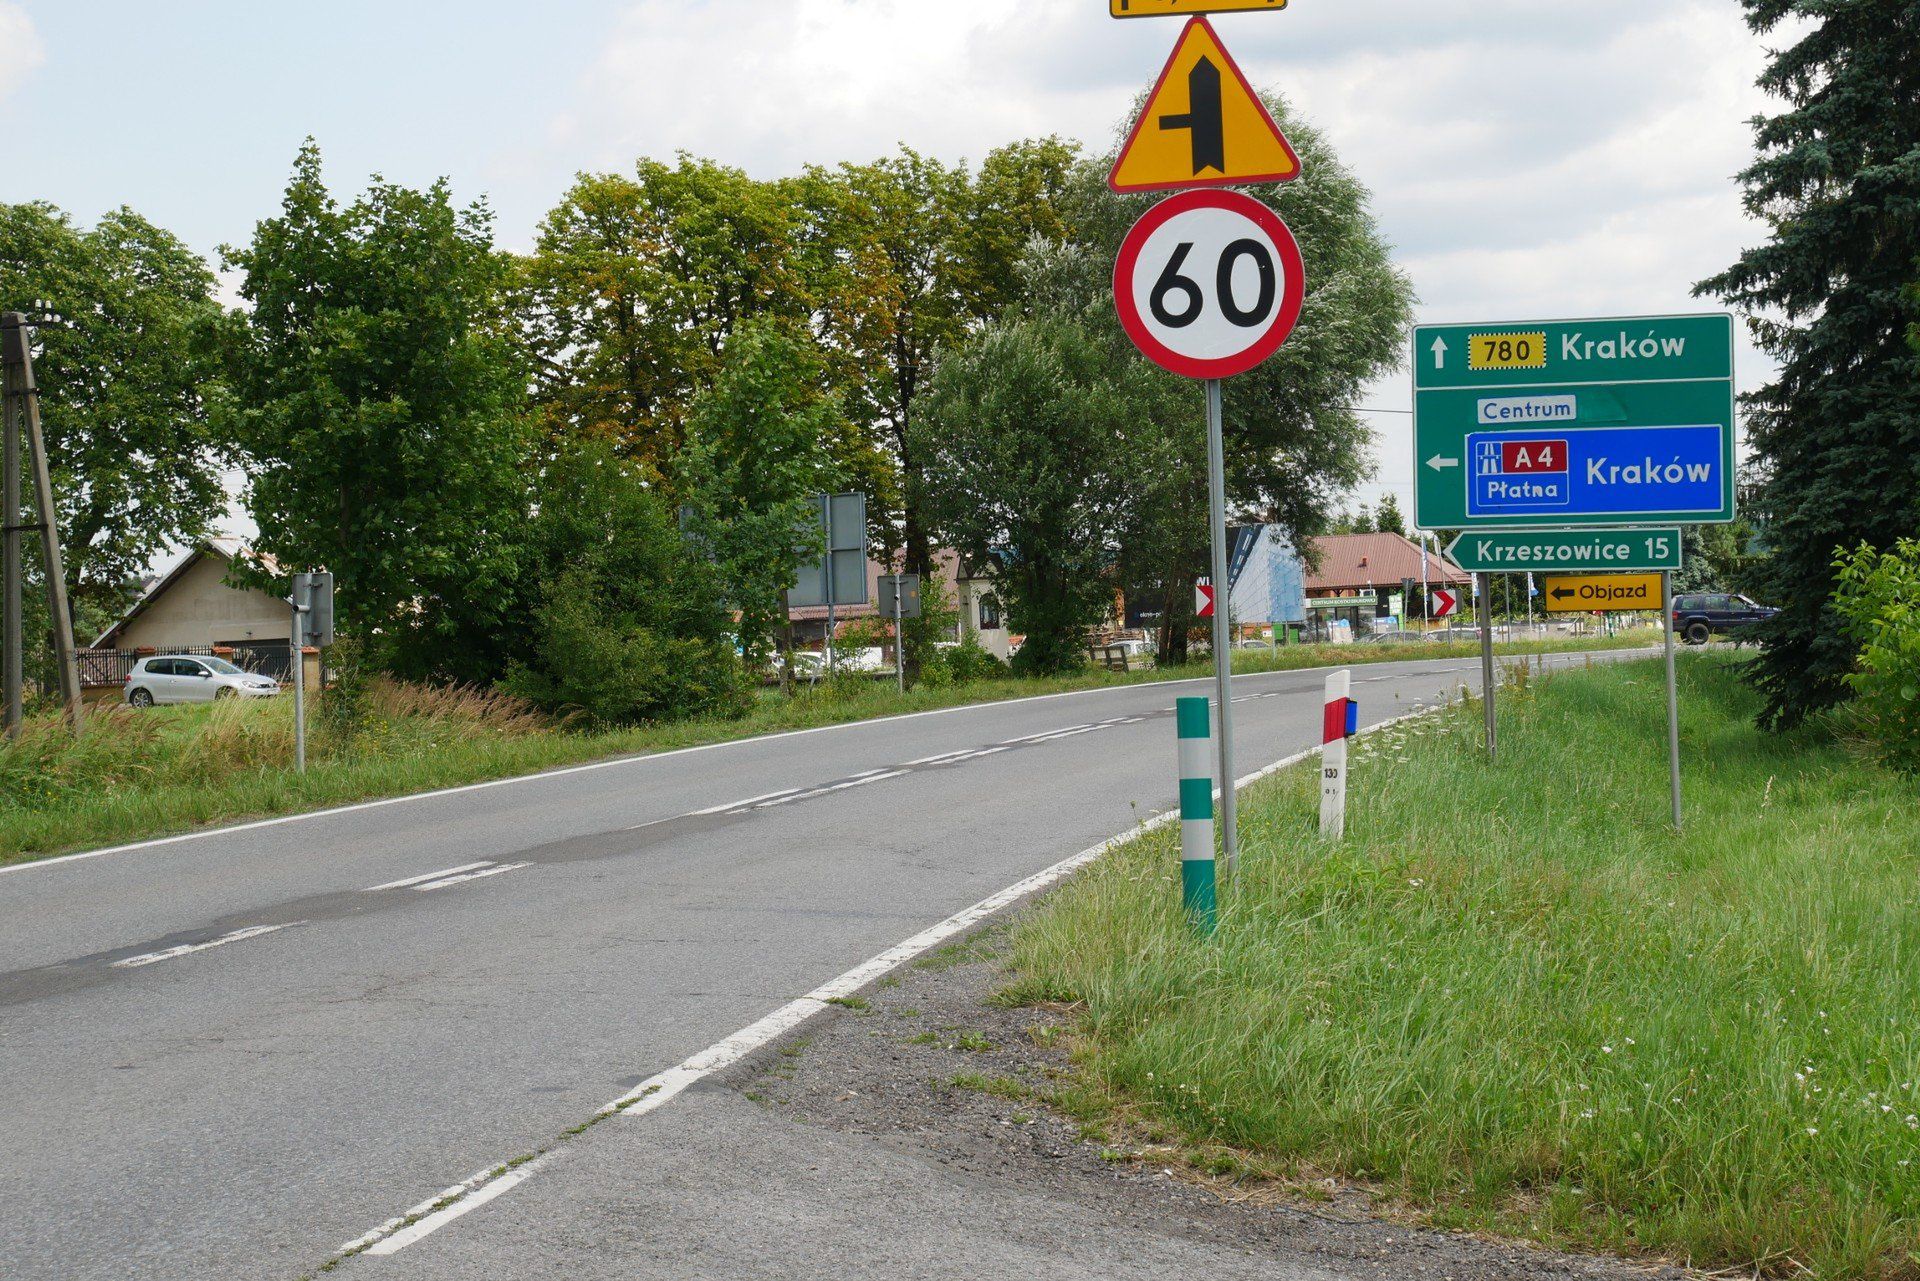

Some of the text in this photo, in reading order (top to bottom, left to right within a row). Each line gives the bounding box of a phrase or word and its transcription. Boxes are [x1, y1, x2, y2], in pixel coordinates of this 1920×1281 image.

[1150, 238, 1276, 328] 60
[1484, 330, 1686, 361] 780 Kraków
[1483, 401, 1570, 419] Centrum
[1587, 455, 1711, 485] Kraków
[1488, 481, 1558, 498] Płatna
[1477, 537, 1669, 562] Krzeszowice 15
[1579, 584, 1647, 601] Objazd
